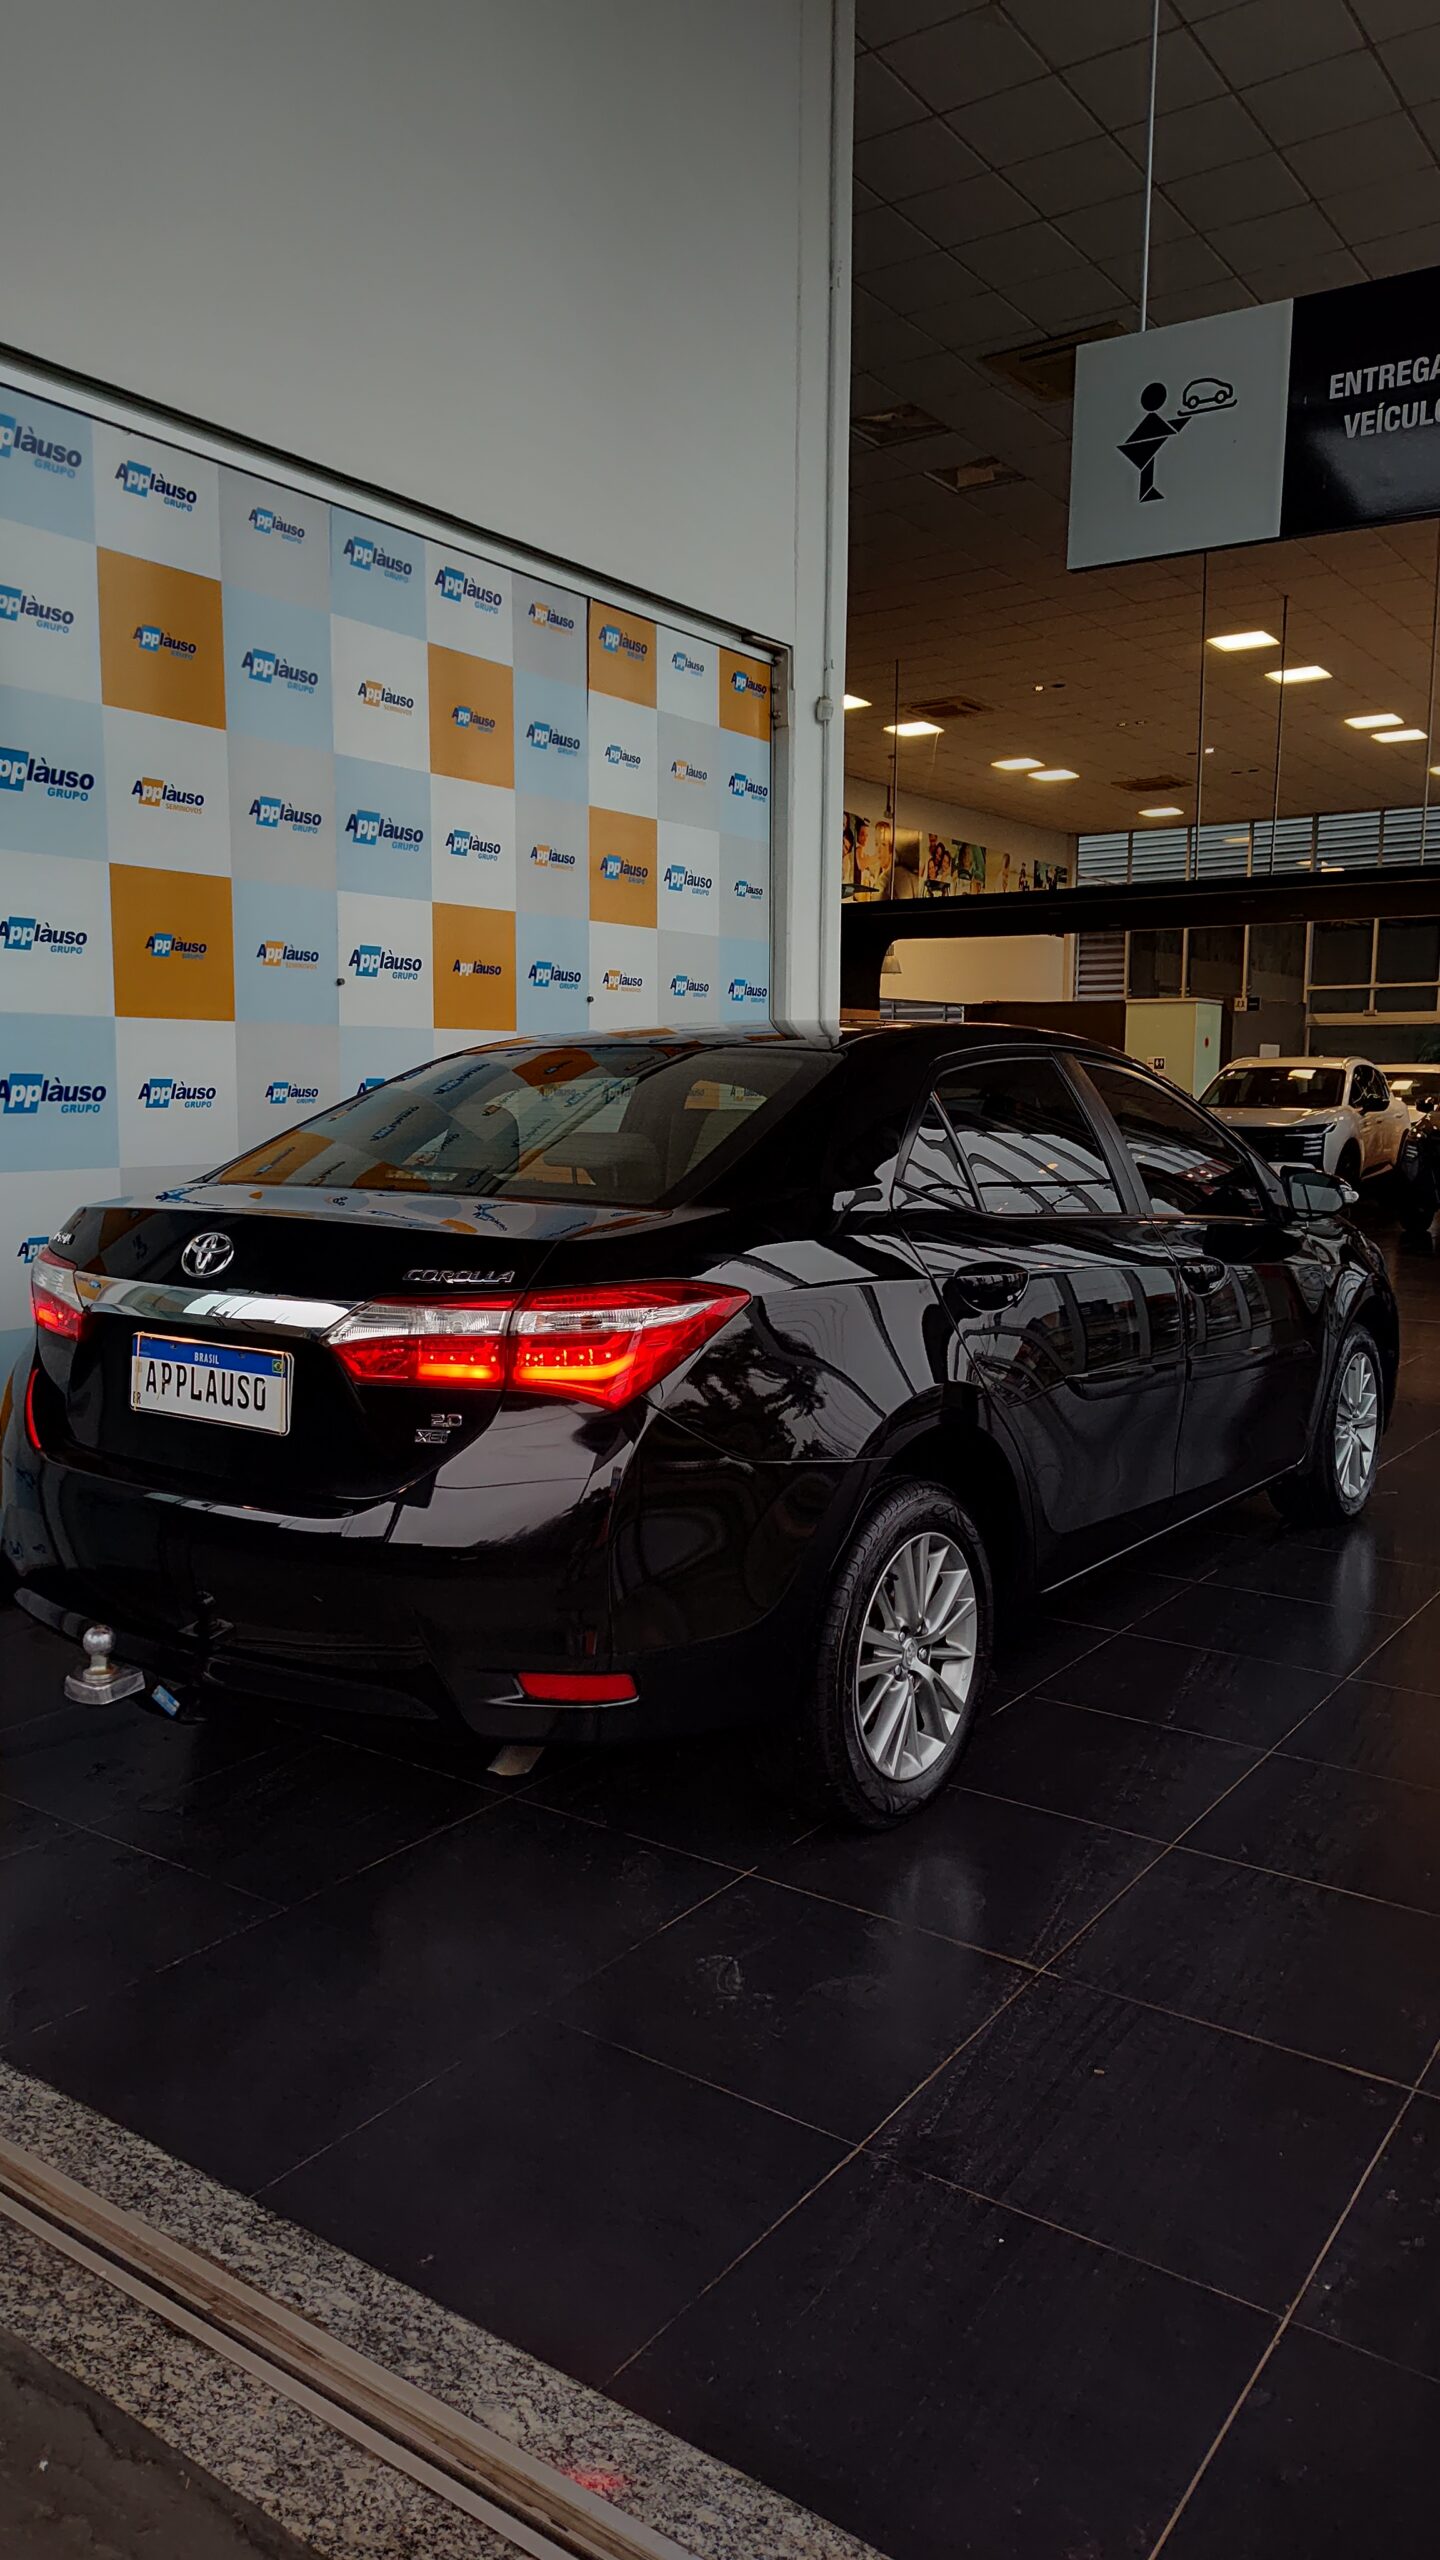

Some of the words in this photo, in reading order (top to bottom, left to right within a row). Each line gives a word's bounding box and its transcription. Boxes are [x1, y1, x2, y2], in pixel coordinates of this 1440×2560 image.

[0, 425, 82, 468] plàuso
[33, 458, 76, 479] GRUPO
[115, 461, 197, 504] Applàuso
[163, 497, 193, 512] GRUPO
[248, 508, 305, 538] Applàuso
[343, 538, 412, 575] Applàuso
[434, 569, 502, 606] Applàuso
[0, 594, 75, 625] pplàuso
[474, 601, 499, 615] GRUPO
[528, 603, 575, 629] Applàuso
[36, 619, 70, 635] GRUPO
[133, 626, 197, 655] Applàuso
[599, 626, 648, 654] Applàuso
[241, 651, 319, 686] Applàuso
[671, 653, 705, 673] Applàuso
[286, 681, 315, 694] GRUPO
[730, 672, 767, 694] Applàuso
[357, 682, 414, 709] Applàuso
[452, 707, 495, 729] Applàuso
[526, 723, 581, 750] Applàuso
[605, 746, 641, 765] Applàuso
[0, 757, 95, 790] pplàuso
[671, 761, 708, 781] Applàuso
[47, 786, 89, 802] GRUPO
[131, 779, 205, 806] Applàuso
[728, 775, 768, 797] Applàuso
[165, 802, 203, 815] SEMINOVOS
[249, 799, 322, 827] Applàuso
[292, 824, 318, 834] GRUPO
[345, 813, 424, 843] Applàuso
[391, 840, 420, 852] GRUPO
[445, 832, 501, 856] Applàuso
[477, 852, 498, 862] GRUPO
[530, 846, 576, 866] Applàuso
[600, 857, 649, 879] Applàuso
[664, 868, 713, 890] Applàuso
[734, 882, 764, 897] Applàuso
[0, 920, 88, 946] Applàuso
[50, 944, 83, 955] GRUPO
[145, 936, 207, 955] Applàuso
[256, 943, 320, 963] Applàuso
[348, 949, 422, 974] Applàuso
[452, 959, 502, 977] Applàuso
[391, 970, 418, 981] GRUPO
[528, 964, 582, 984] Applàuso
[602, 972, 643, 989] Applàuso
[559, 982, 579, 990] GRUPO
[670, 978, 710, 994] Applàuso
[728, 981, 768, 998] Applàuso
[0, 1077, 107, 1108] Applàuso
[138, 1080, 217, 1107] Applàuso
[265, 1083, 319, 1103] Applàuso
[295, 1097, 317, 1105] GRUPO
[61, 1104, 101, 1114] GRUPO
[184, 1100, 213, 1109] GRUPO
[402, 1269, 516, 1284] COROLLA
[194, 1351, 220, 1365] BRASIL
[145, 1360, 266, 1411] APPLAUSO
[431, 1413, 463, 1428] 2.0
